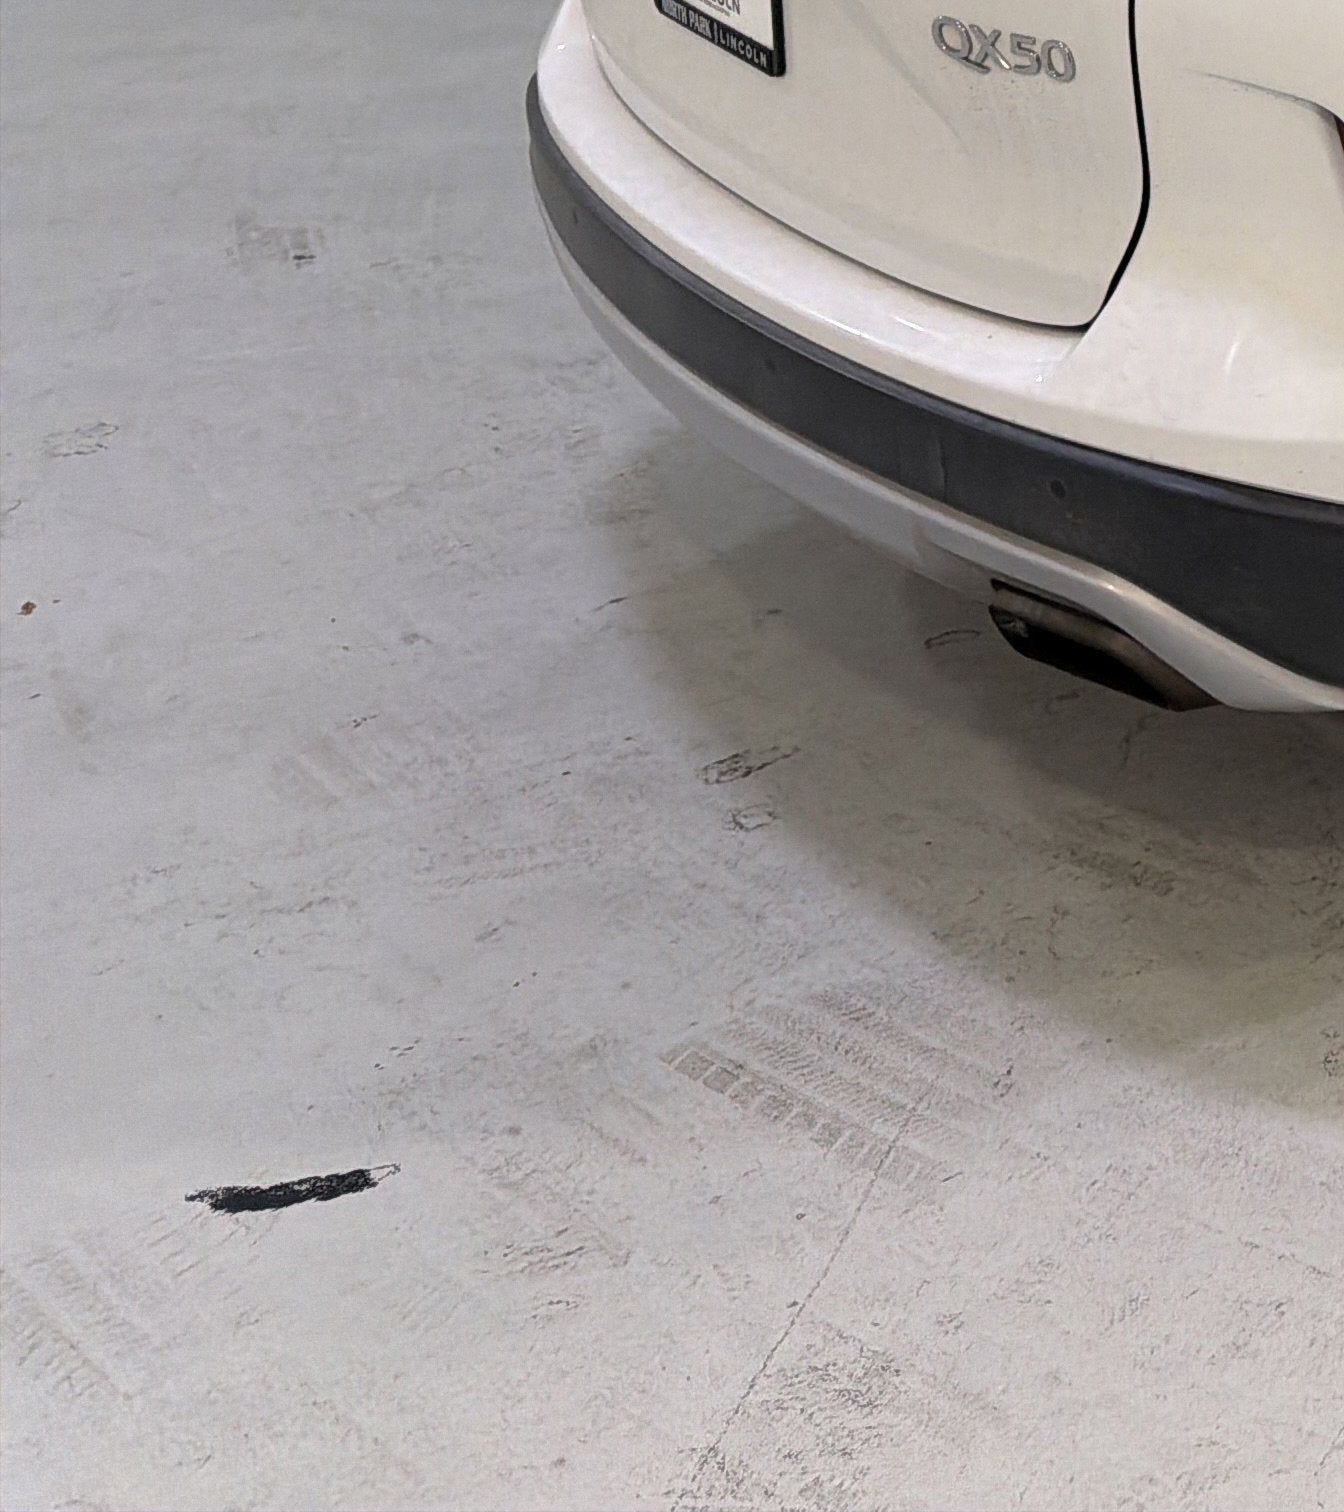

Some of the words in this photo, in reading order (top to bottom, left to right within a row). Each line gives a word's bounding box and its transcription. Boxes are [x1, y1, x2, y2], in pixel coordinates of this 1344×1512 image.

[688, 9, 712, 39] PARK
[720, 29, 767, 67] LINCOLN
[931, 15, 1076, 83] QX50
